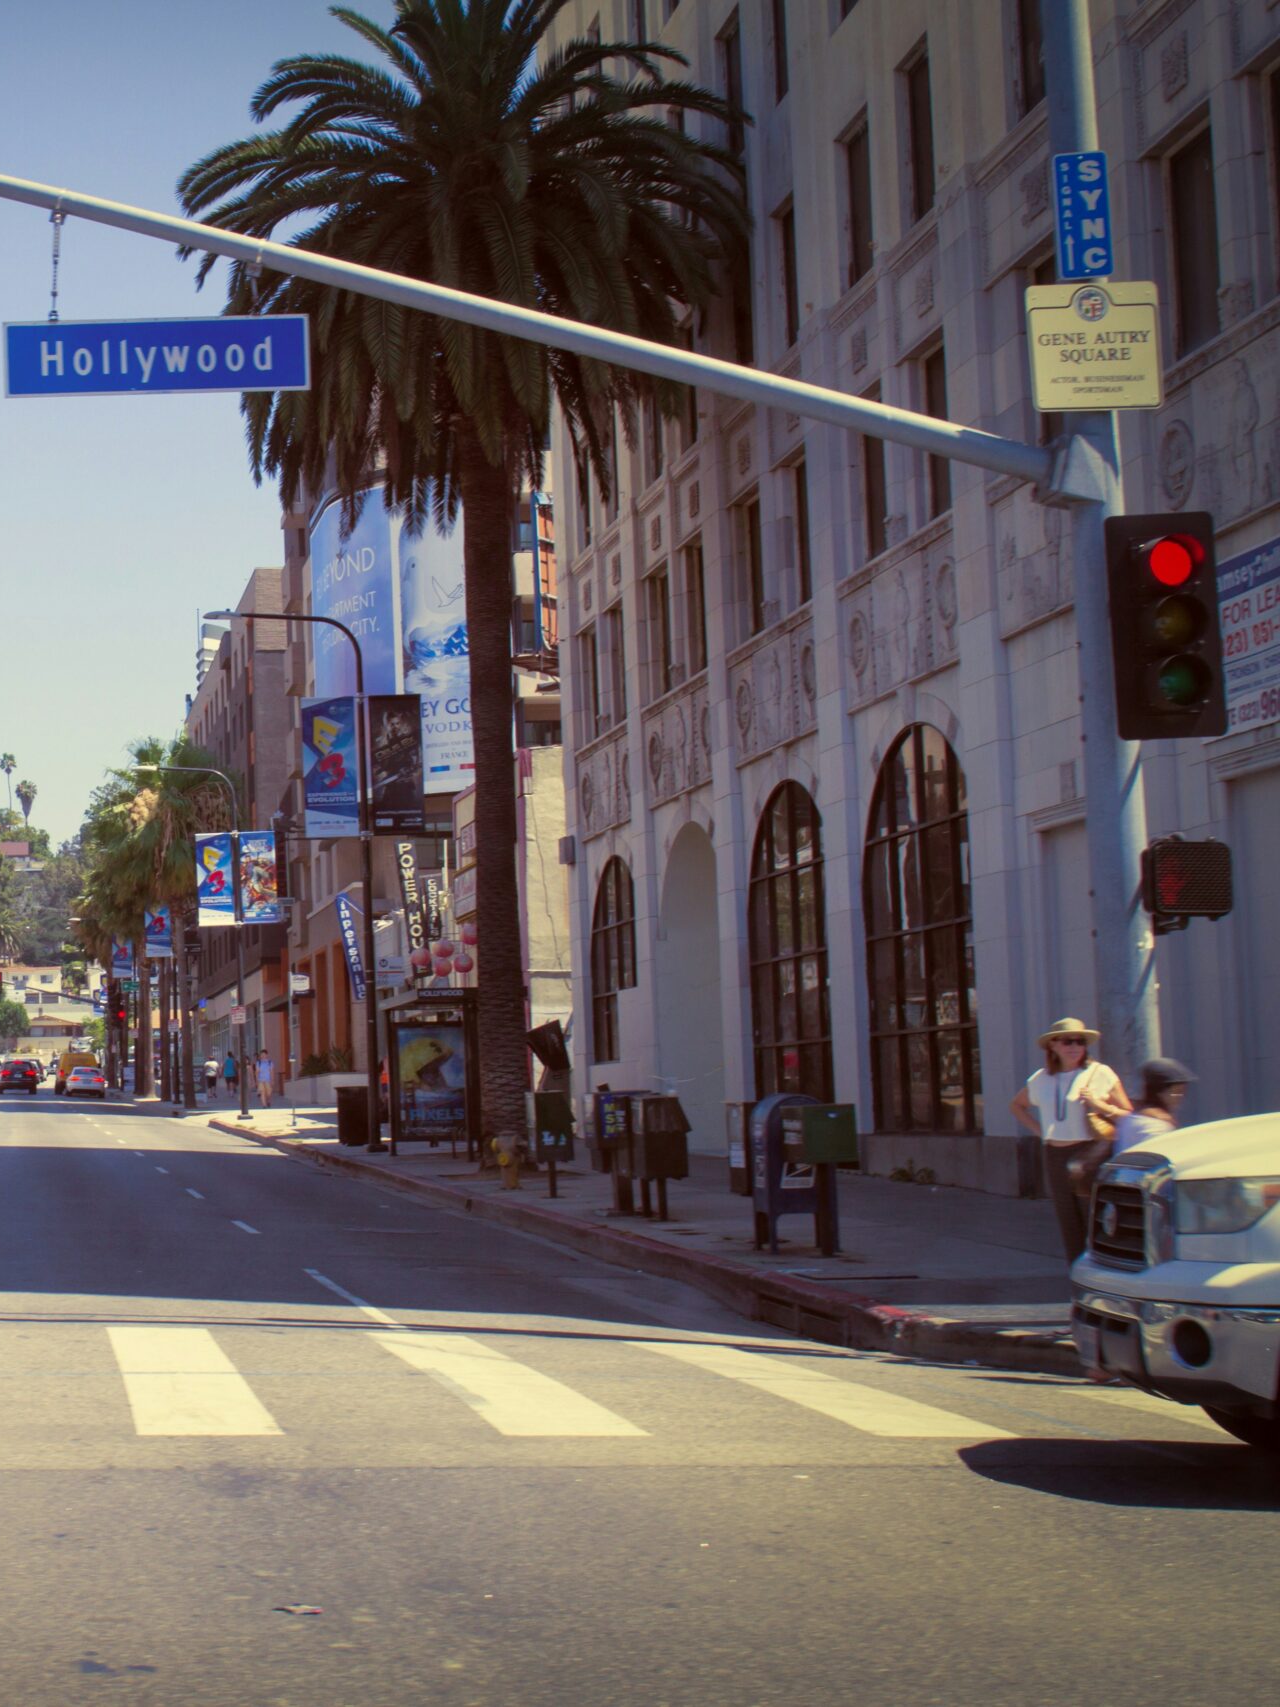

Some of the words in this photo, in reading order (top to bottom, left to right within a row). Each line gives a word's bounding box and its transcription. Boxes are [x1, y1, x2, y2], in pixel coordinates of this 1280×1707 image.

[1059, 162, 1073, 230] SIGNAL
[1077, 159, 1108, 270] SYNC
[40, 335, 272, 383] Hollywood
[1038, 332, 1087, 347] GENE
[1094, 330, 1150, 345] AUTRY
[1059, 348, 1132, 365] SQUARE
[1222, 598, 1252, 628] FOR
[1257, 584, 1280, 614] LEA
[421, 700, 439, 719] EY
[445, 698, 472, 715] GO
[425, 720, 472, 735] VODK
[398, 842, 418, 904] POWER
[408, 911, 424, 949] HOU
